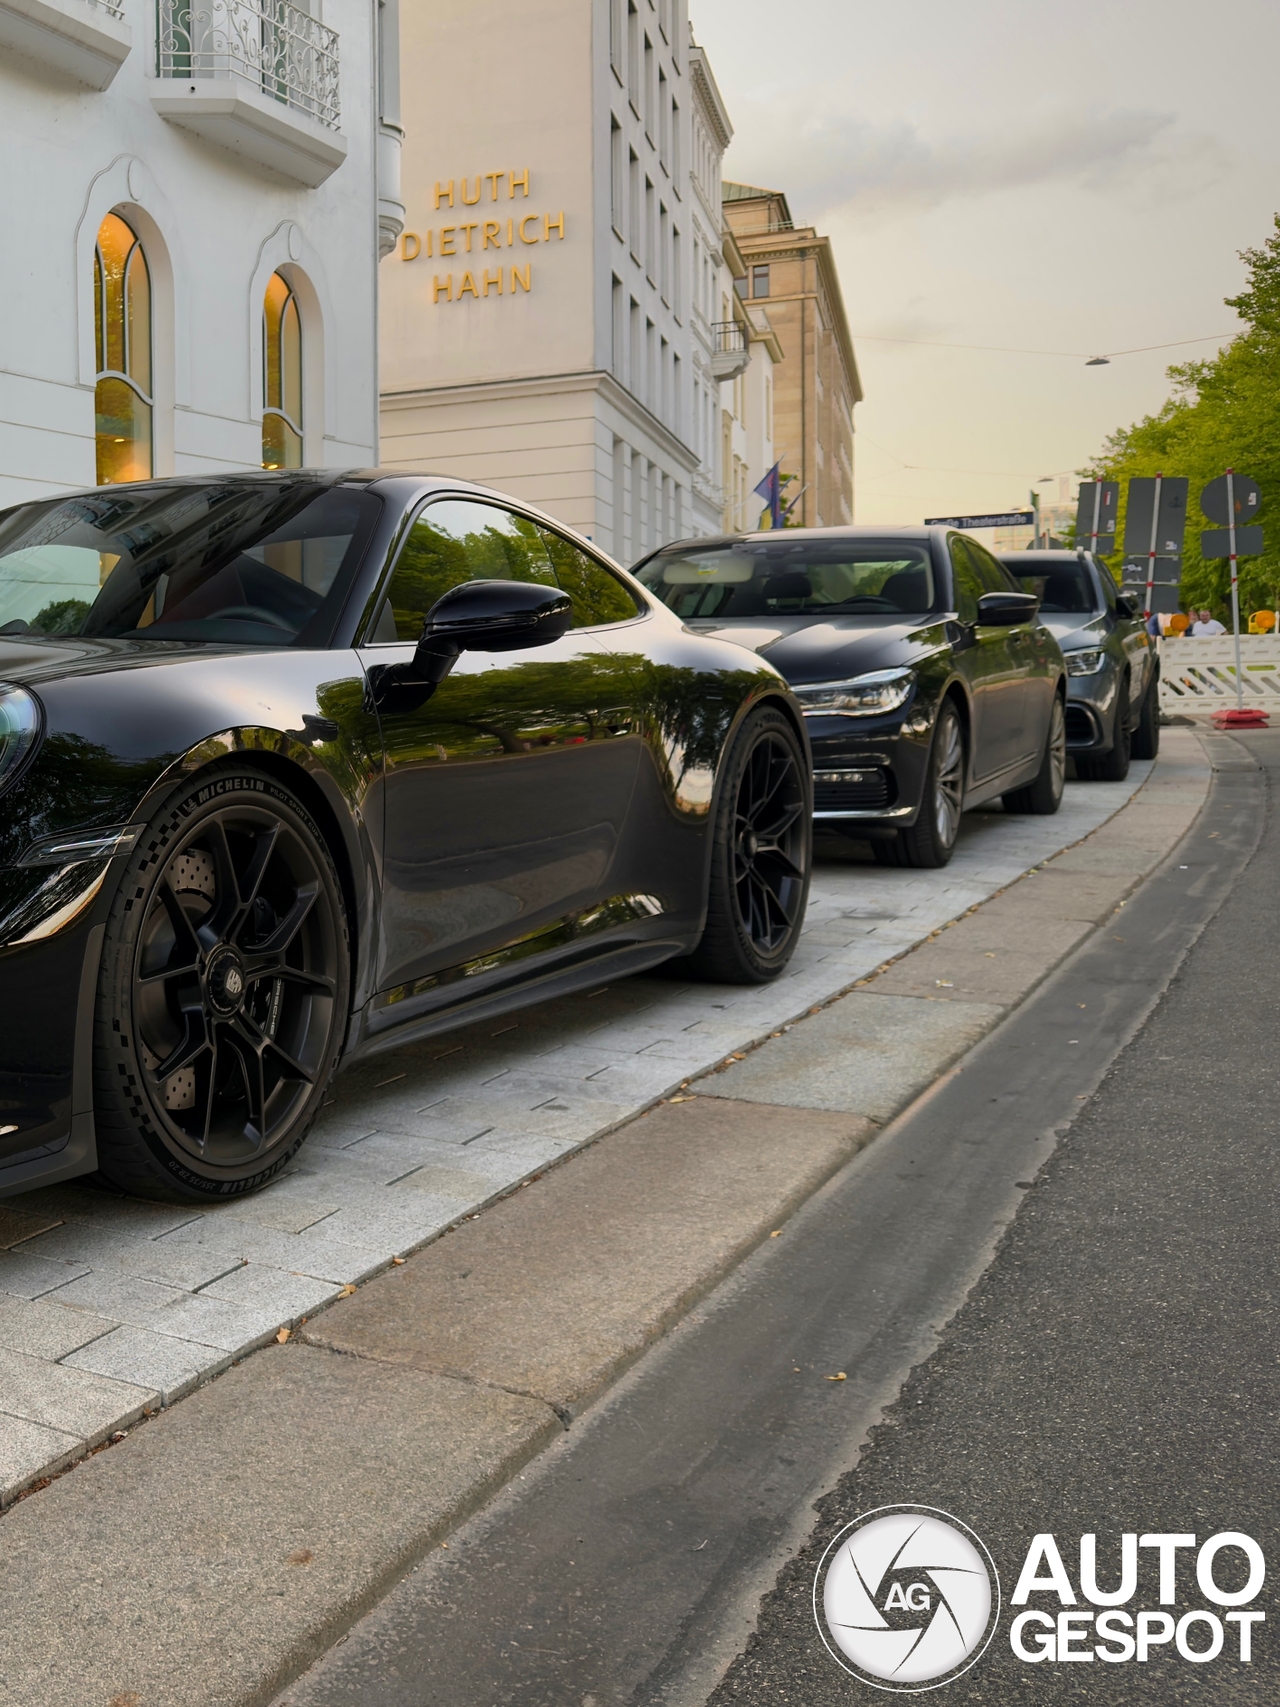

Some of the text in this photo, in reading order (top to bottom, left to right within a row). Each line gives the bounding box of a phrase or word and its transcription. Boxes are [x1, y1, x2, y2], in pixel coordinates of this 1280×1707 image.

[434, 168, 529, 210] HUTH
[401, 211, 565, 261] DIETRICH
[433, 263, 531, 304] HAHN
[962, 514, 1027, 527] Theaterstraße
[198, 778, 264, 804] MICHELIN
[270, 786, 319, 837] PILOT SPORT CUP
[168, 1160, 180, 1171] 20
[189, 1176, 217, 1190] 255/35
[219, 1155, 287, 1194] MICHELIN
